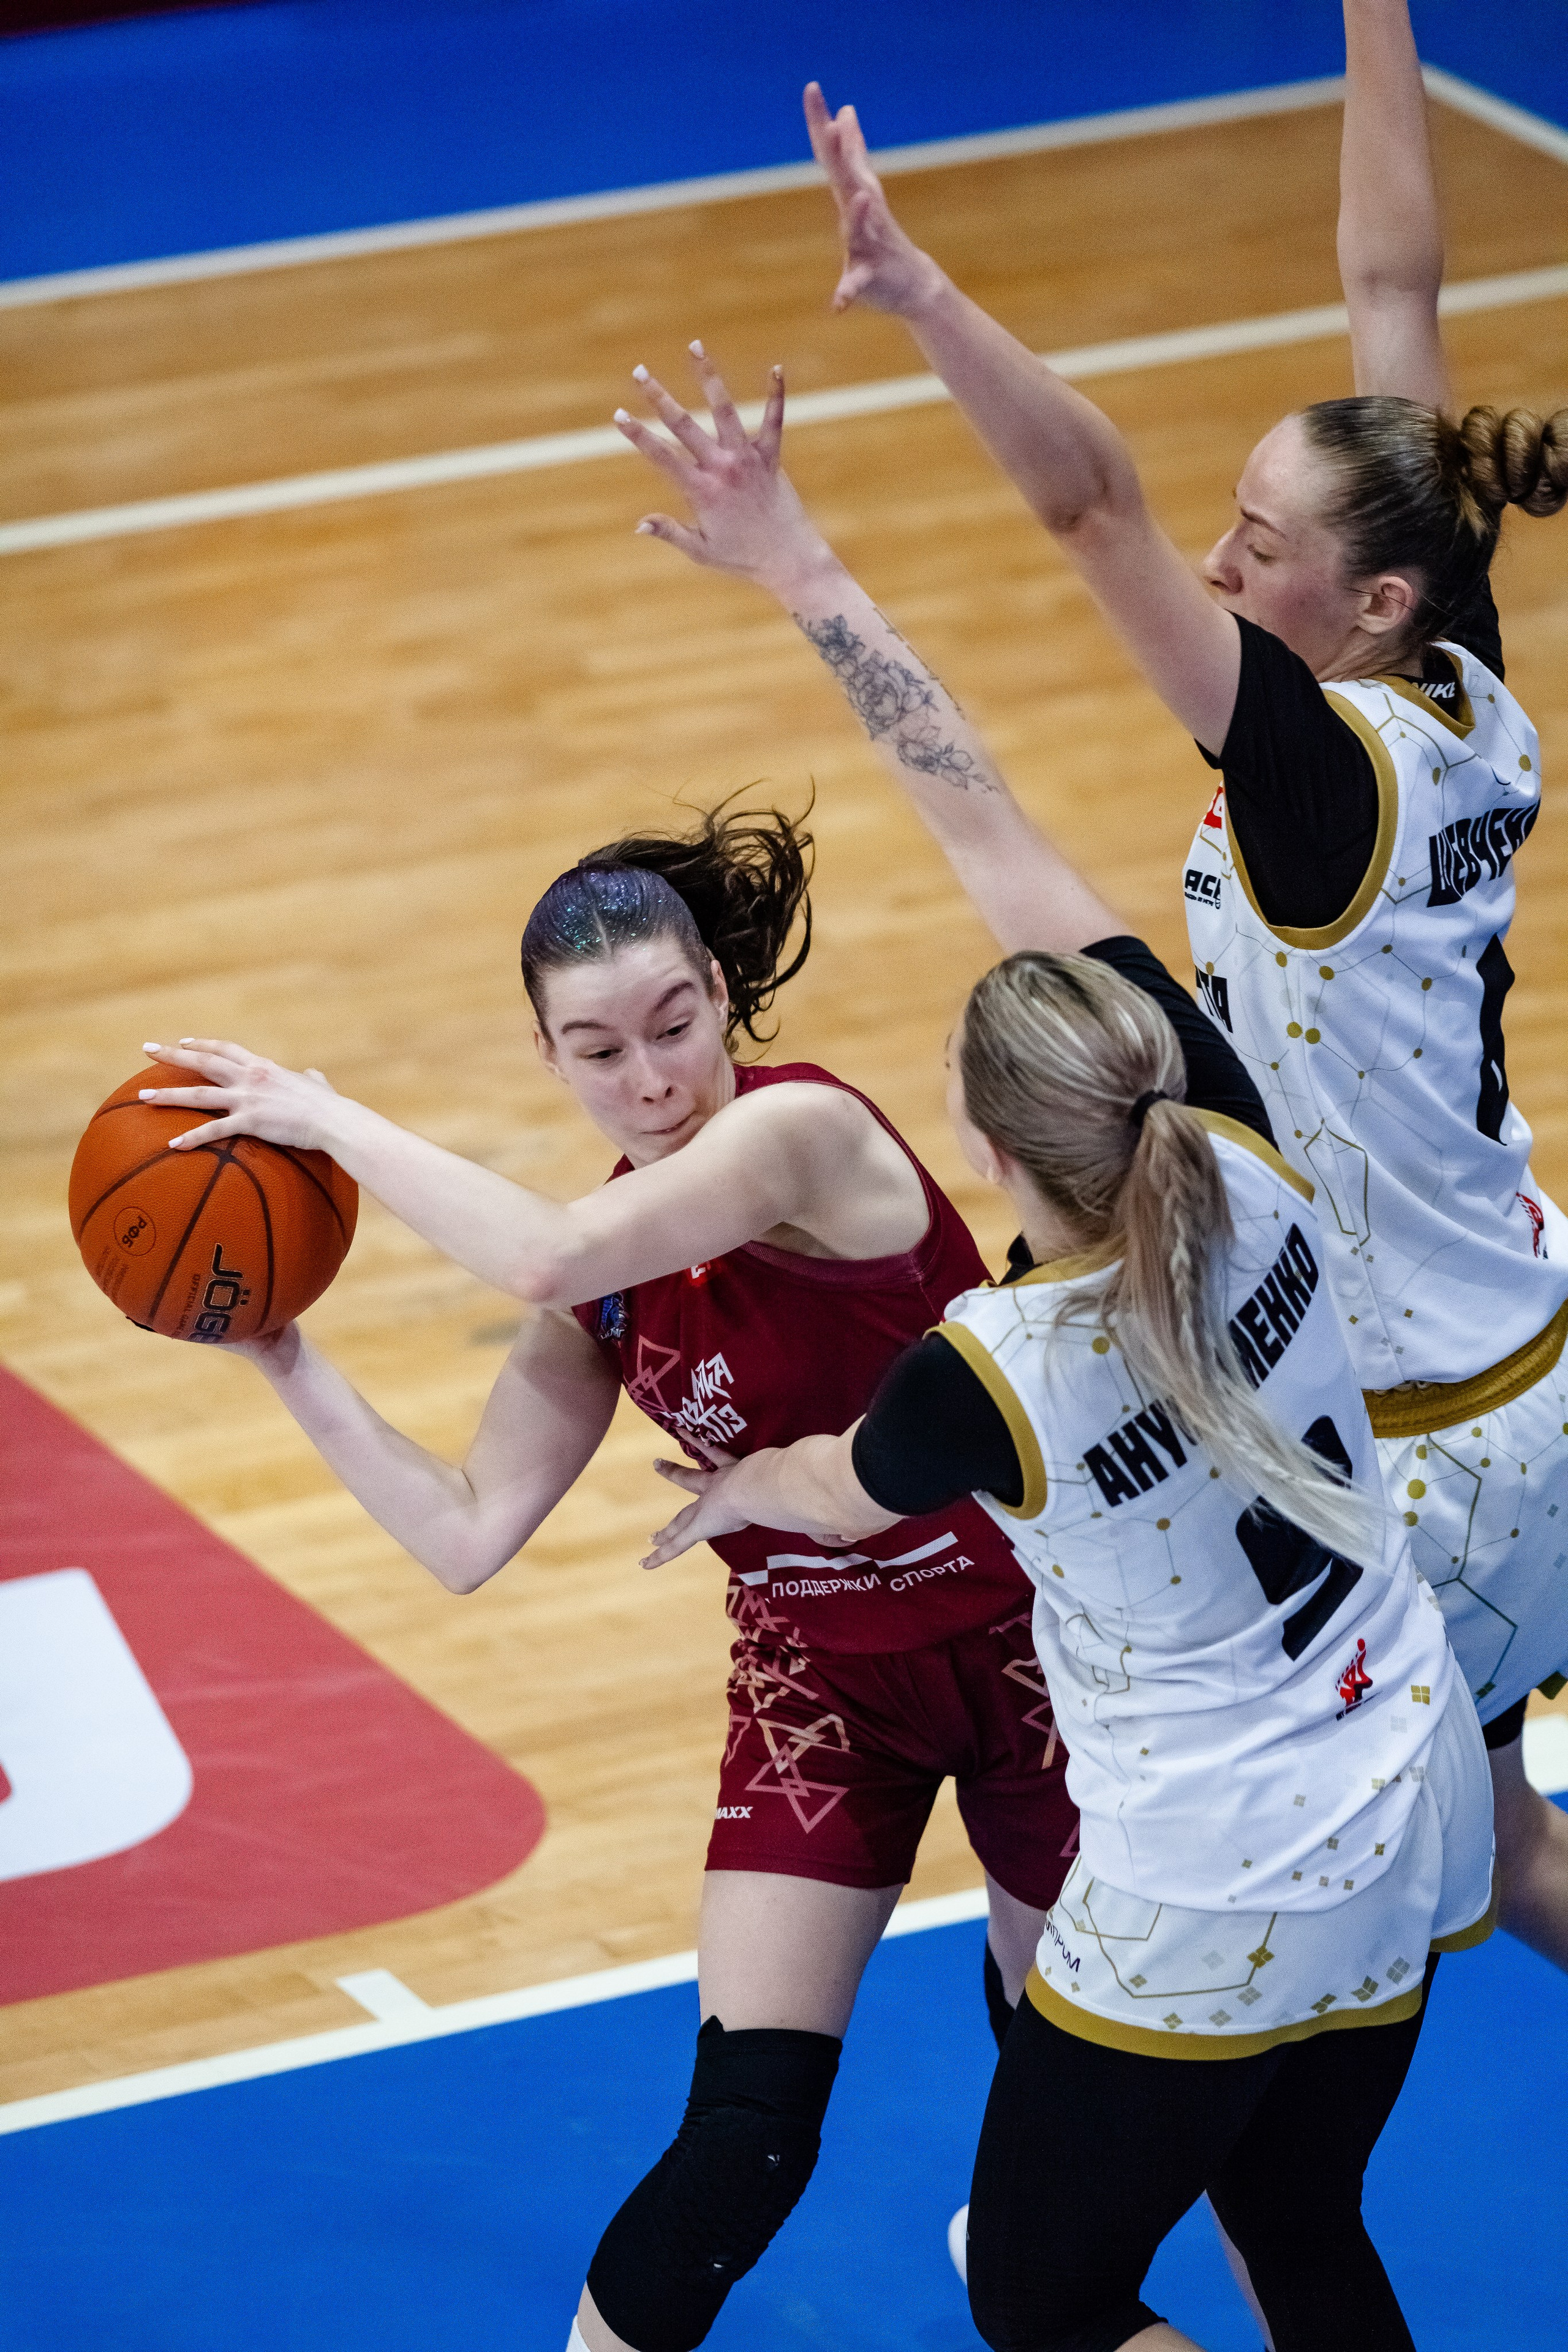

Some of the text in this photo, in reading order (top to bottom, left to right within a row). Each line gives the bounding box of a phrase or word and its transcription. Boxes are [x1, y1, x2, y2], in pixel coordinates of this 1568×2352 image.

[122, 1215, 148, 1248] РФБ
[772, 1555, 975, 1597] ПОДДЕРЖКИ СПОРТА
